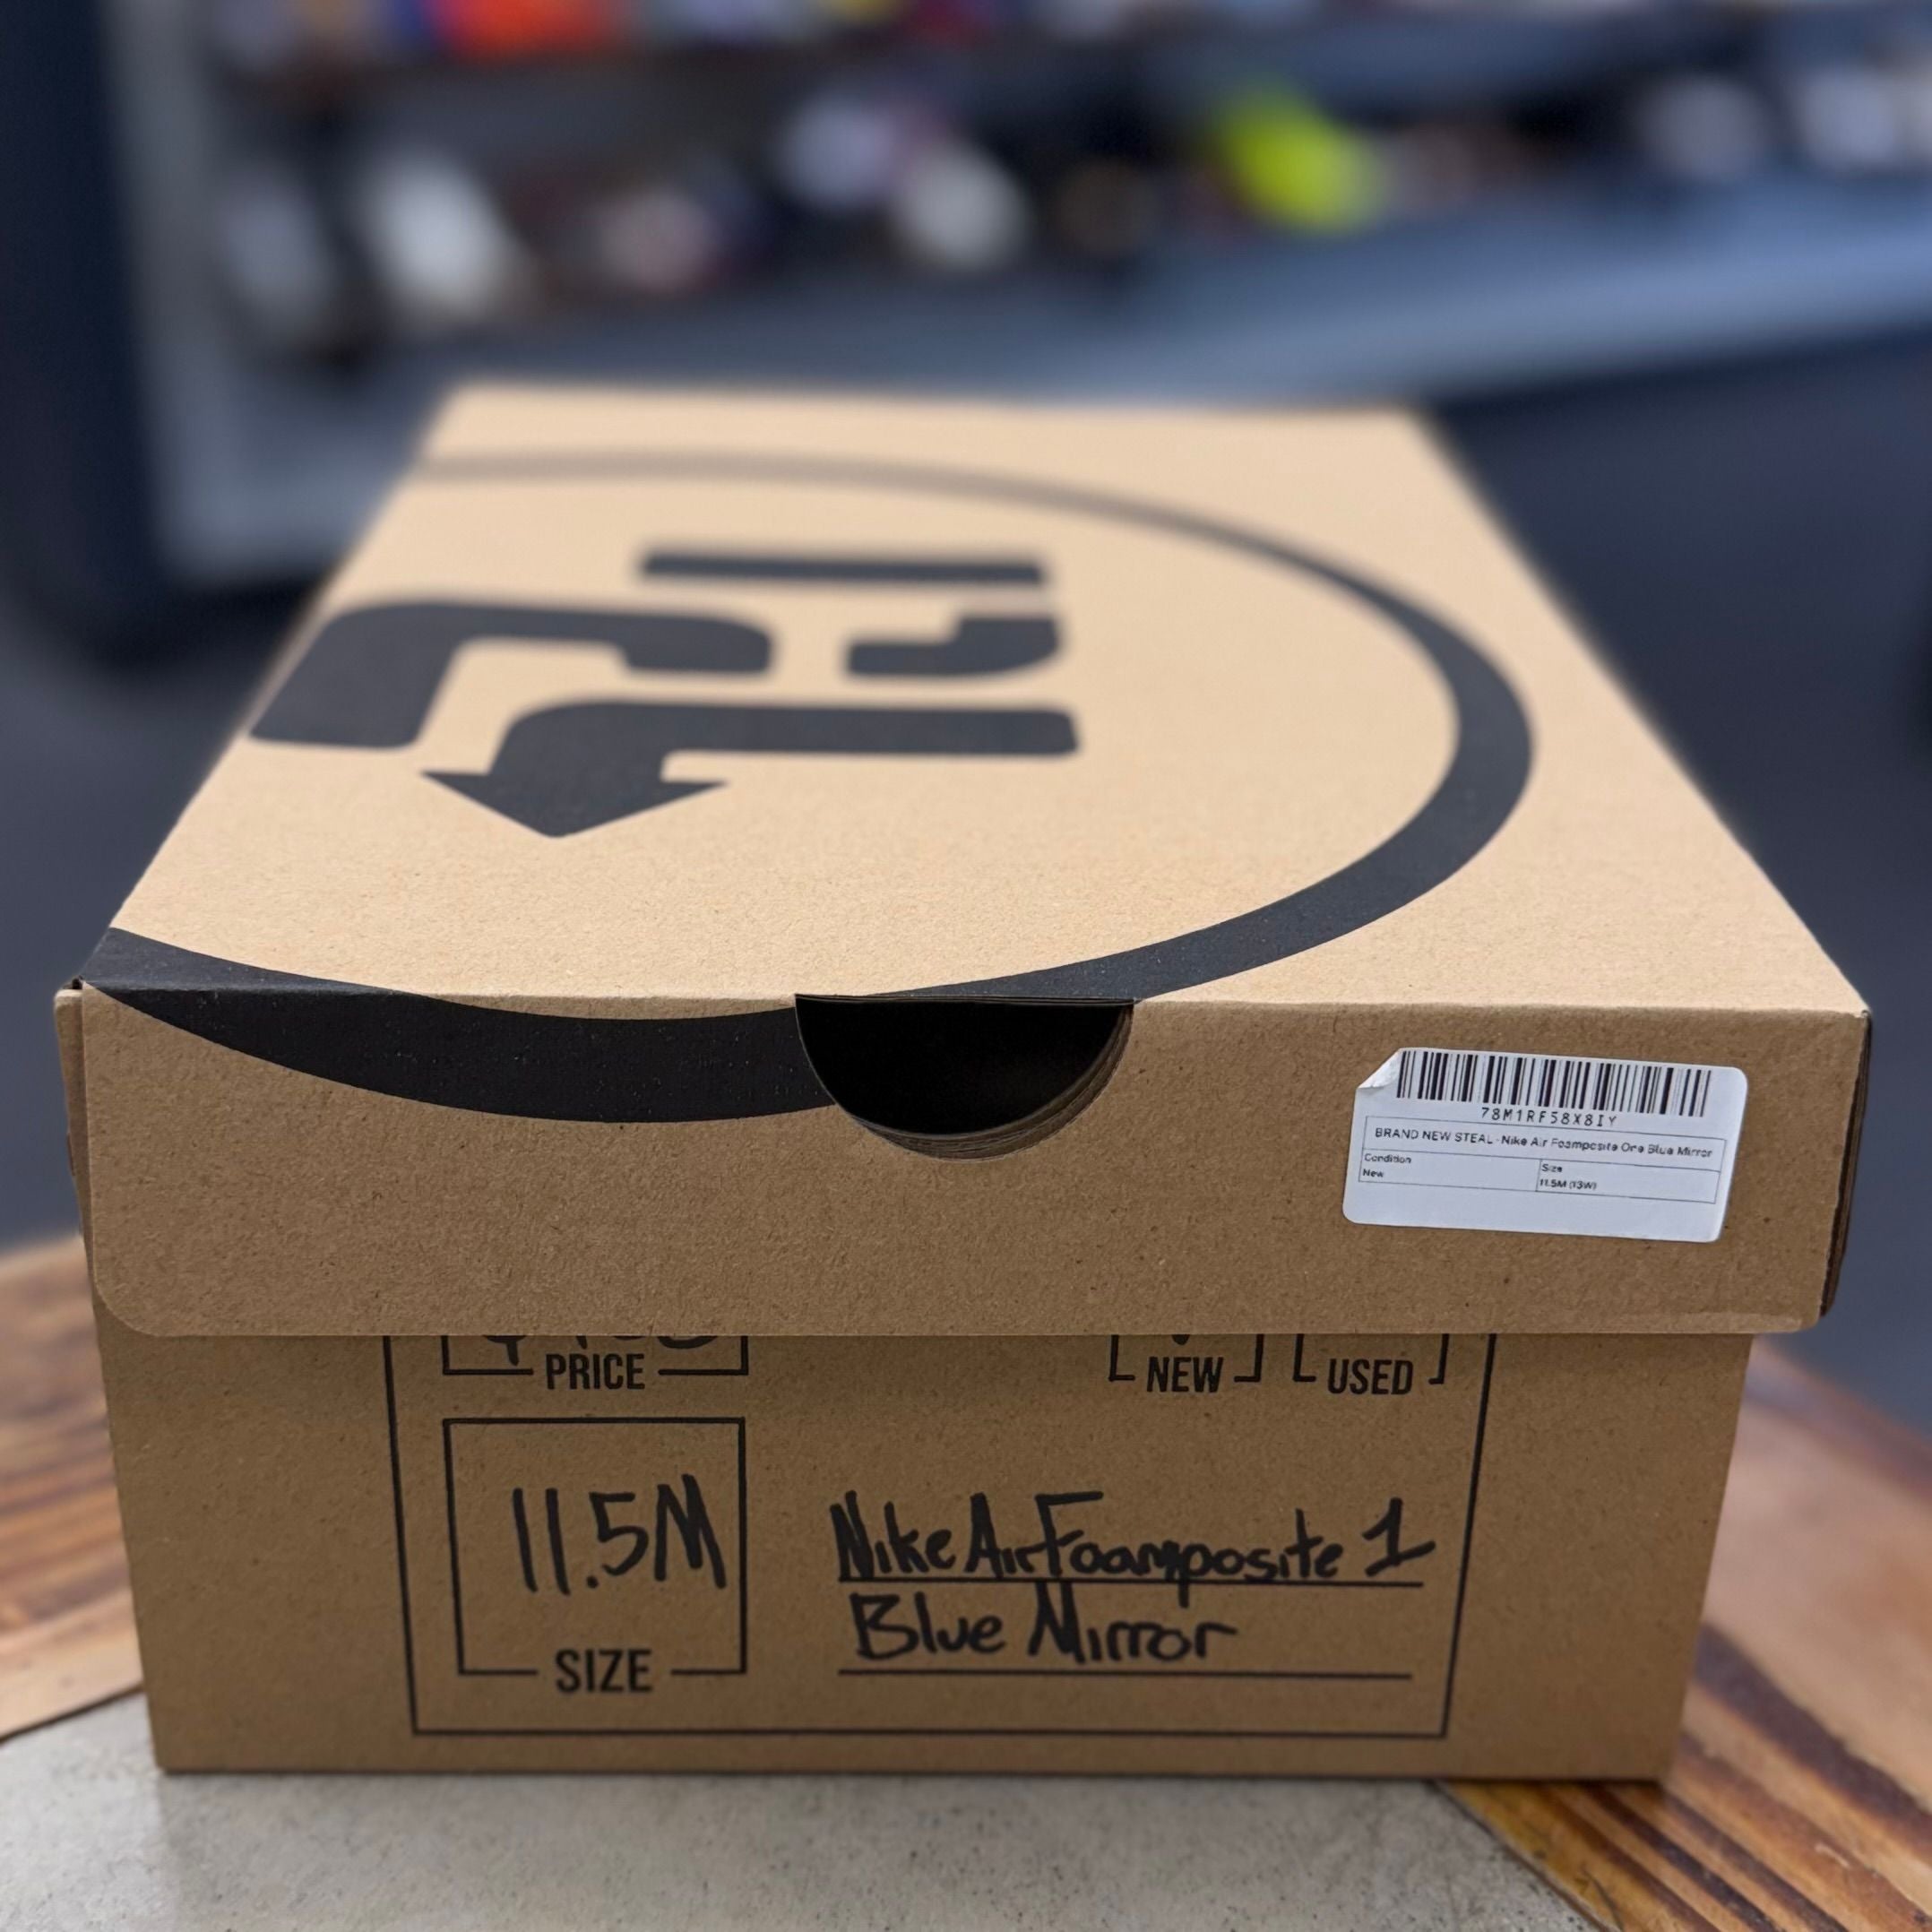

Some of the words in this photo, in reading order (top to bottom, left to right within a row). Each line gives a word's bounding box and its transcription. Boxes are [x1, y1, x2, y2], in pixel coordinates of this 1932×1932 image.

[1364, 1153, 1412, 1165] Condition
[1376, 1127, 1419, 1140] BRAND
[1422, 1131, 1452, 1142] NEW
[1454, 1133, 1493, 1144] STEAL
[1501, 1135, 1528, 1147] Nike
[1531, 1137, 1548, 1148] Air
[1551, 1138, 1618, 1151] Foamposite
[1621, 1142, 1644, 1153] One
[1648, 1144, 1674, 1156] Blue
[1677, 1146, 1713, 1158] Mirror
[1362, 1168, 1384, 1178] New
[1540, 1178, 1567, 1189] 11.5M
[1541, 1163, 1563, 1174] Size
[545, 1352, 646, 1390] PRICE
[1146, 1356, 1225, 1393] NEW
[1327, 1358, 1414, 1395] USED
[512, 1472, 728, 1596] 11.5M
[830, 1489, 957, 1580] Nike
[1361, 1496, 1436, 1577] 1
[849, 1591, 1006, 1660] Blue
[555, 1648, 653, 1693] SIZE
